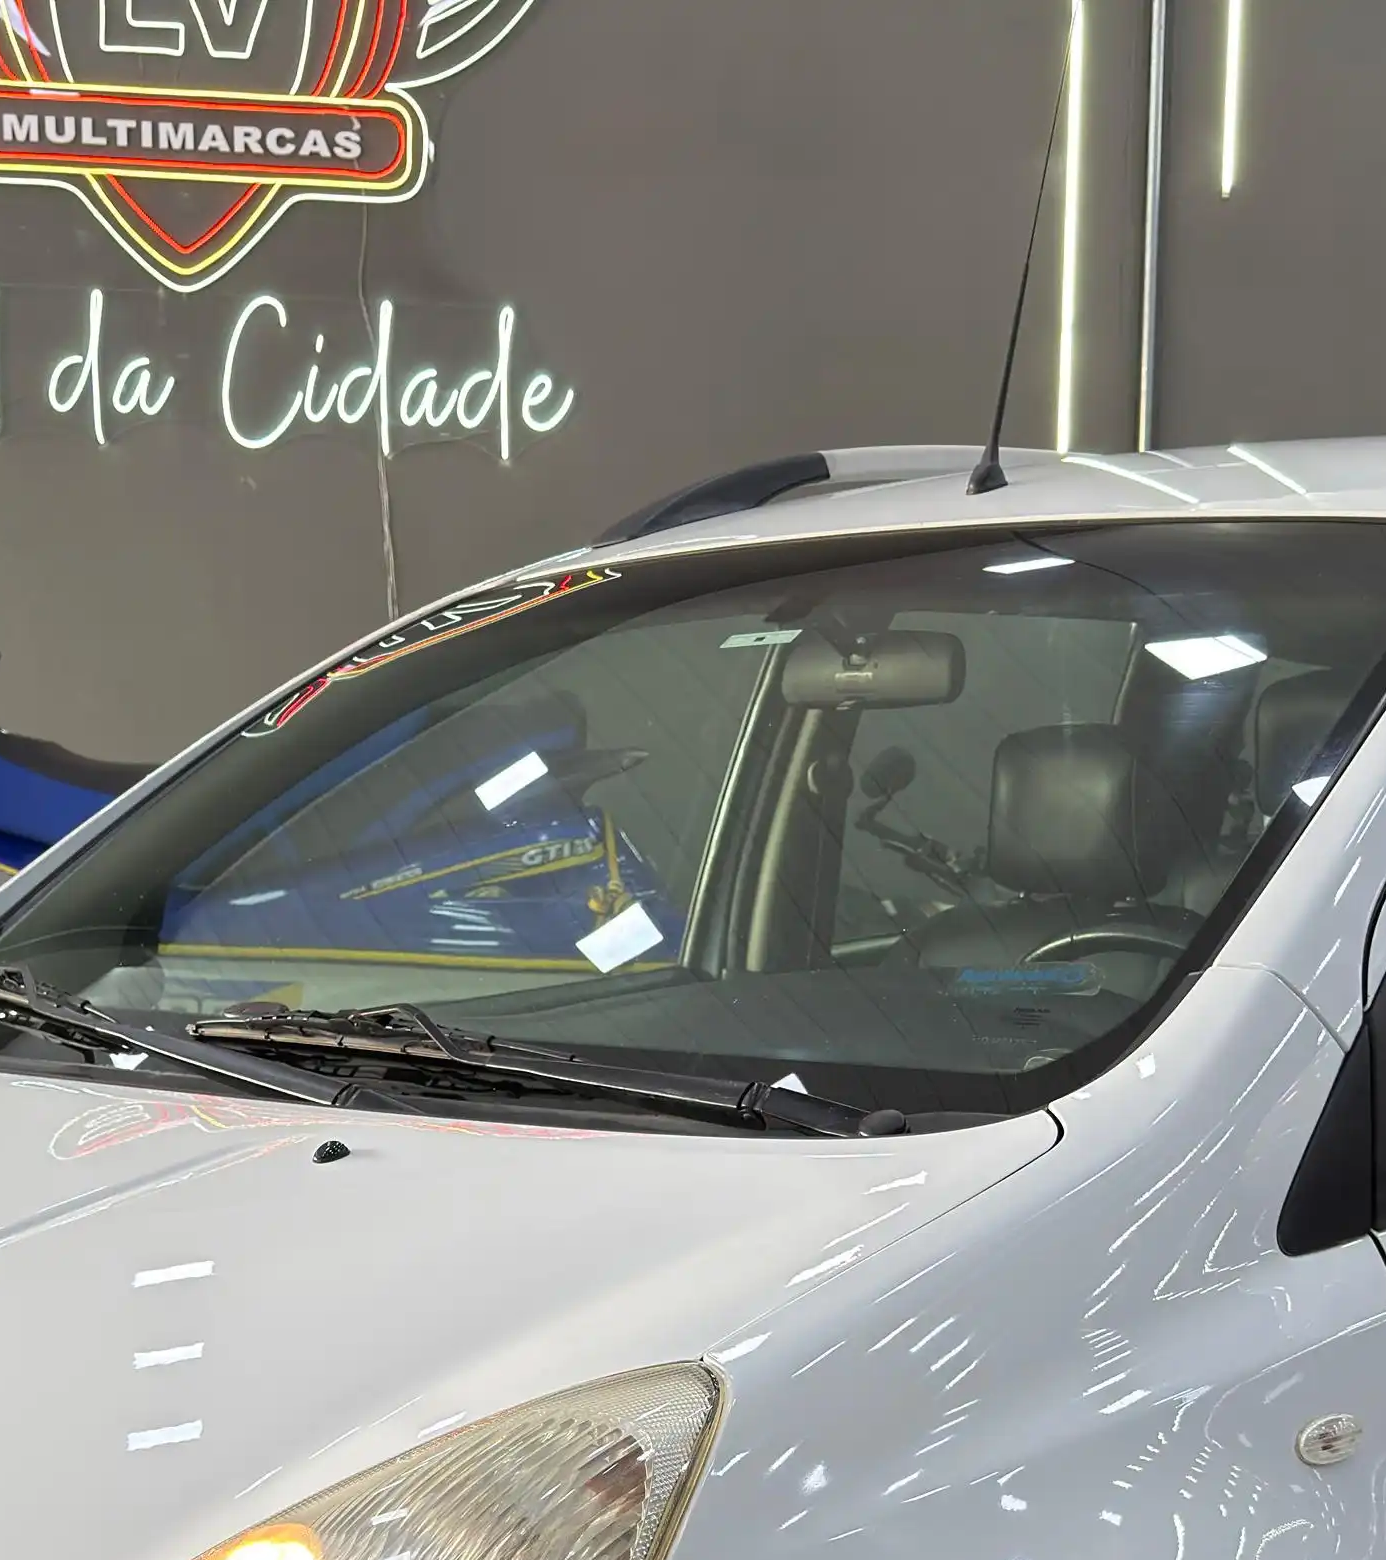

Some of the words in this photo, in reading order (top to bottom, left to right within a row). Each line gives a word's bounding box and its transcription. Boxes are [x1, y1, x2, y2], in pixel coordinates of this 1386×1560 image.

[2, 112, 362, 160] MULTIMARCAS
[48, 289, 175, 446] da
[221, 294, 575, 461] Cidade
